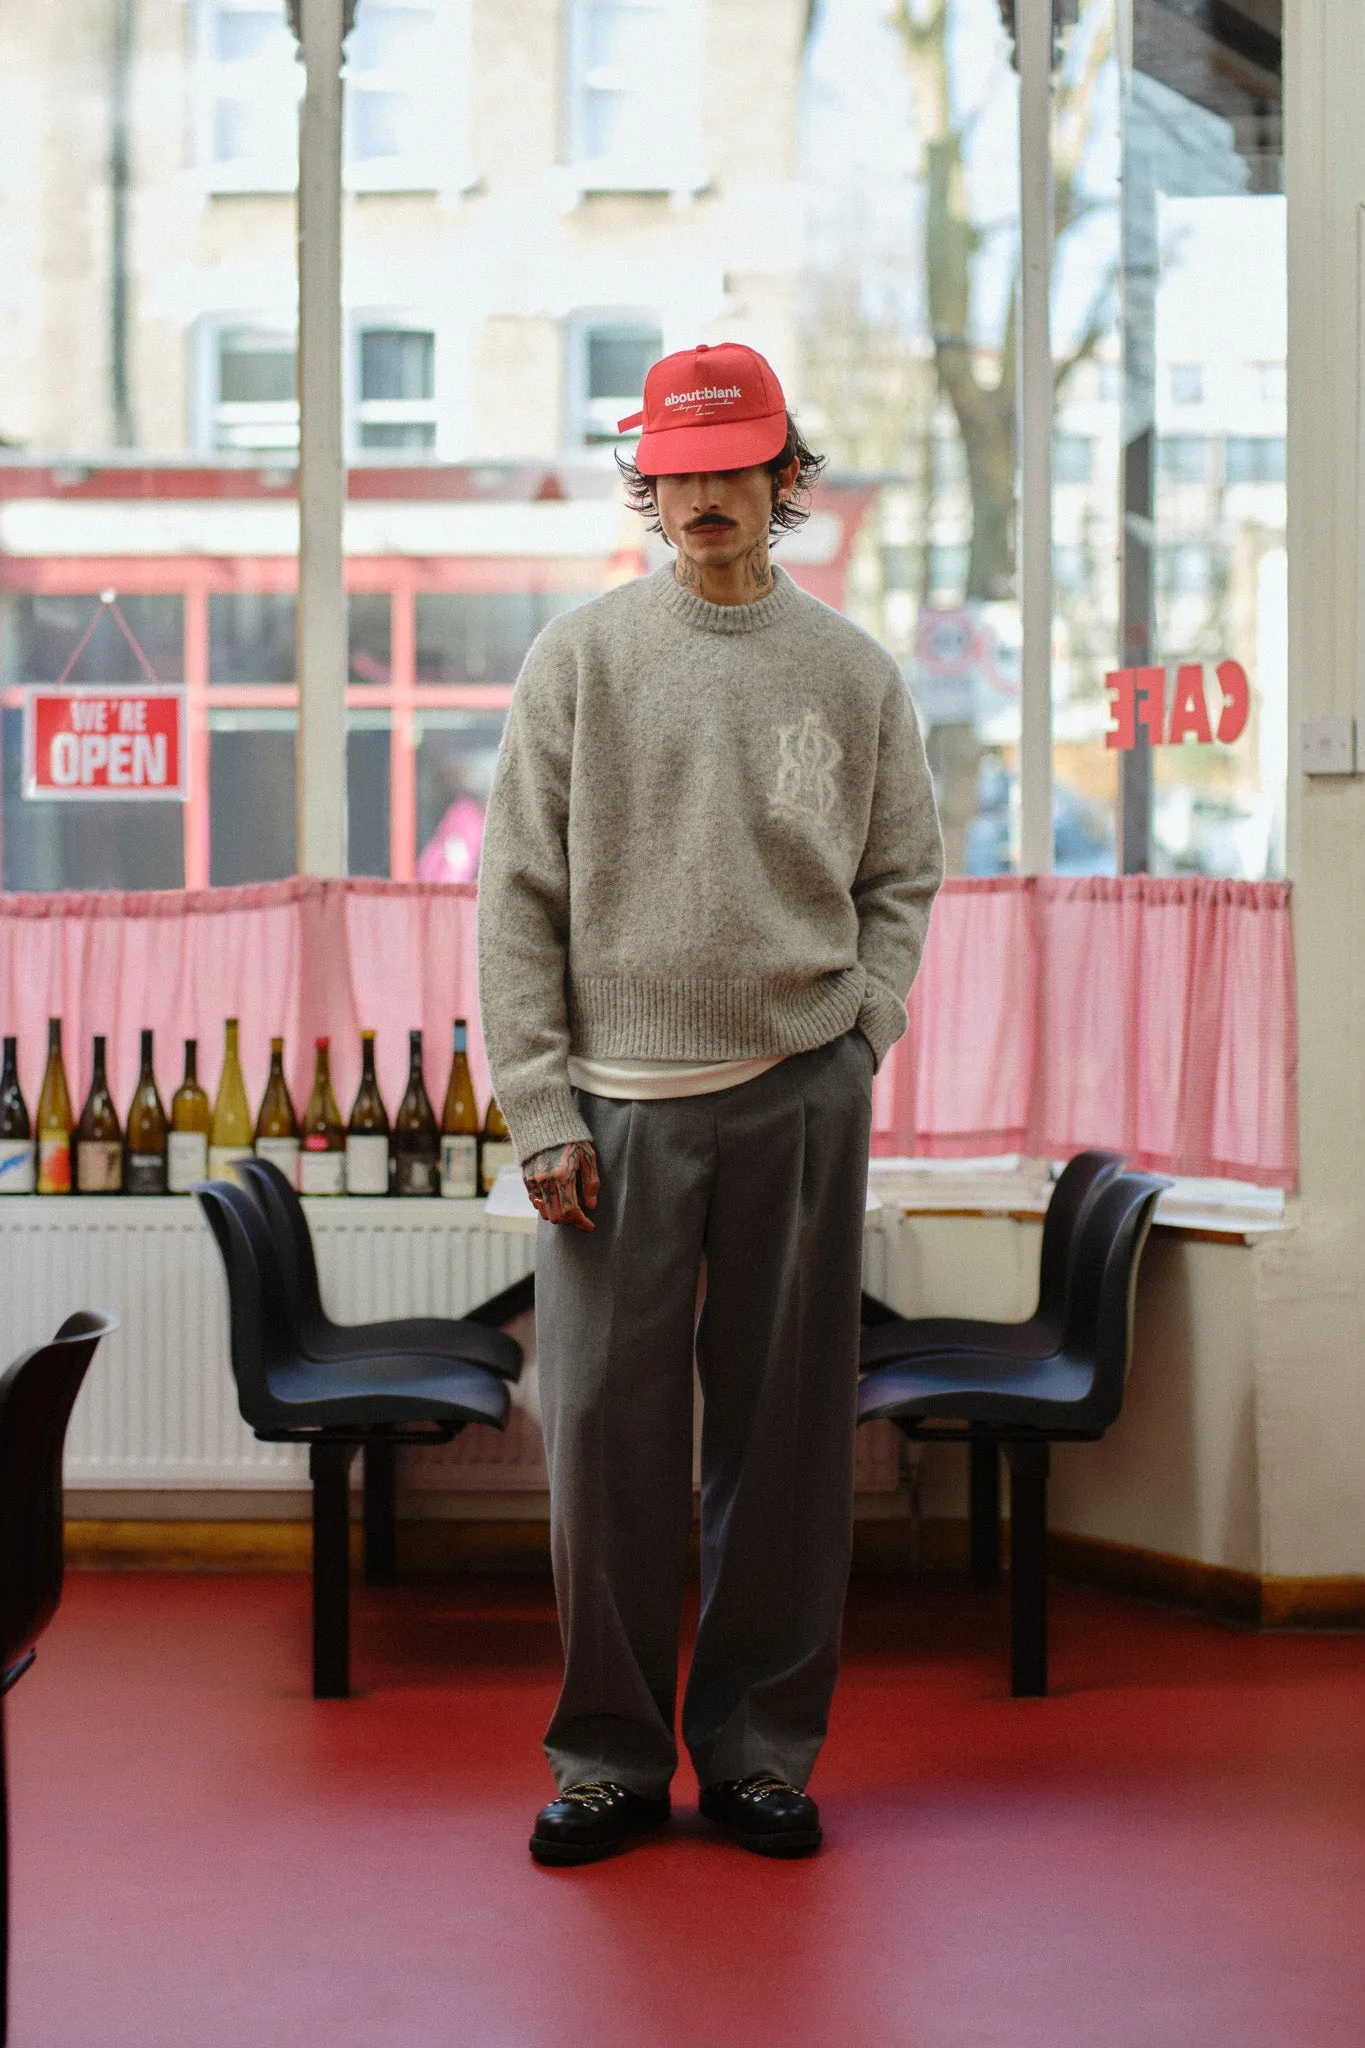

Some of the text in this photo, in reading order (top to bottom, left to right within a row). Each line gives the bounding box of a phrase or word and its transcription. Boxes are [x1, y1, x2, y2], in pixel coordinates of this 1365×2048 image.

[664, 385, 742, 407] about:blank
[70, 700, 148, 731] WE'RE
[51, 731, 168, 785] OPEN
